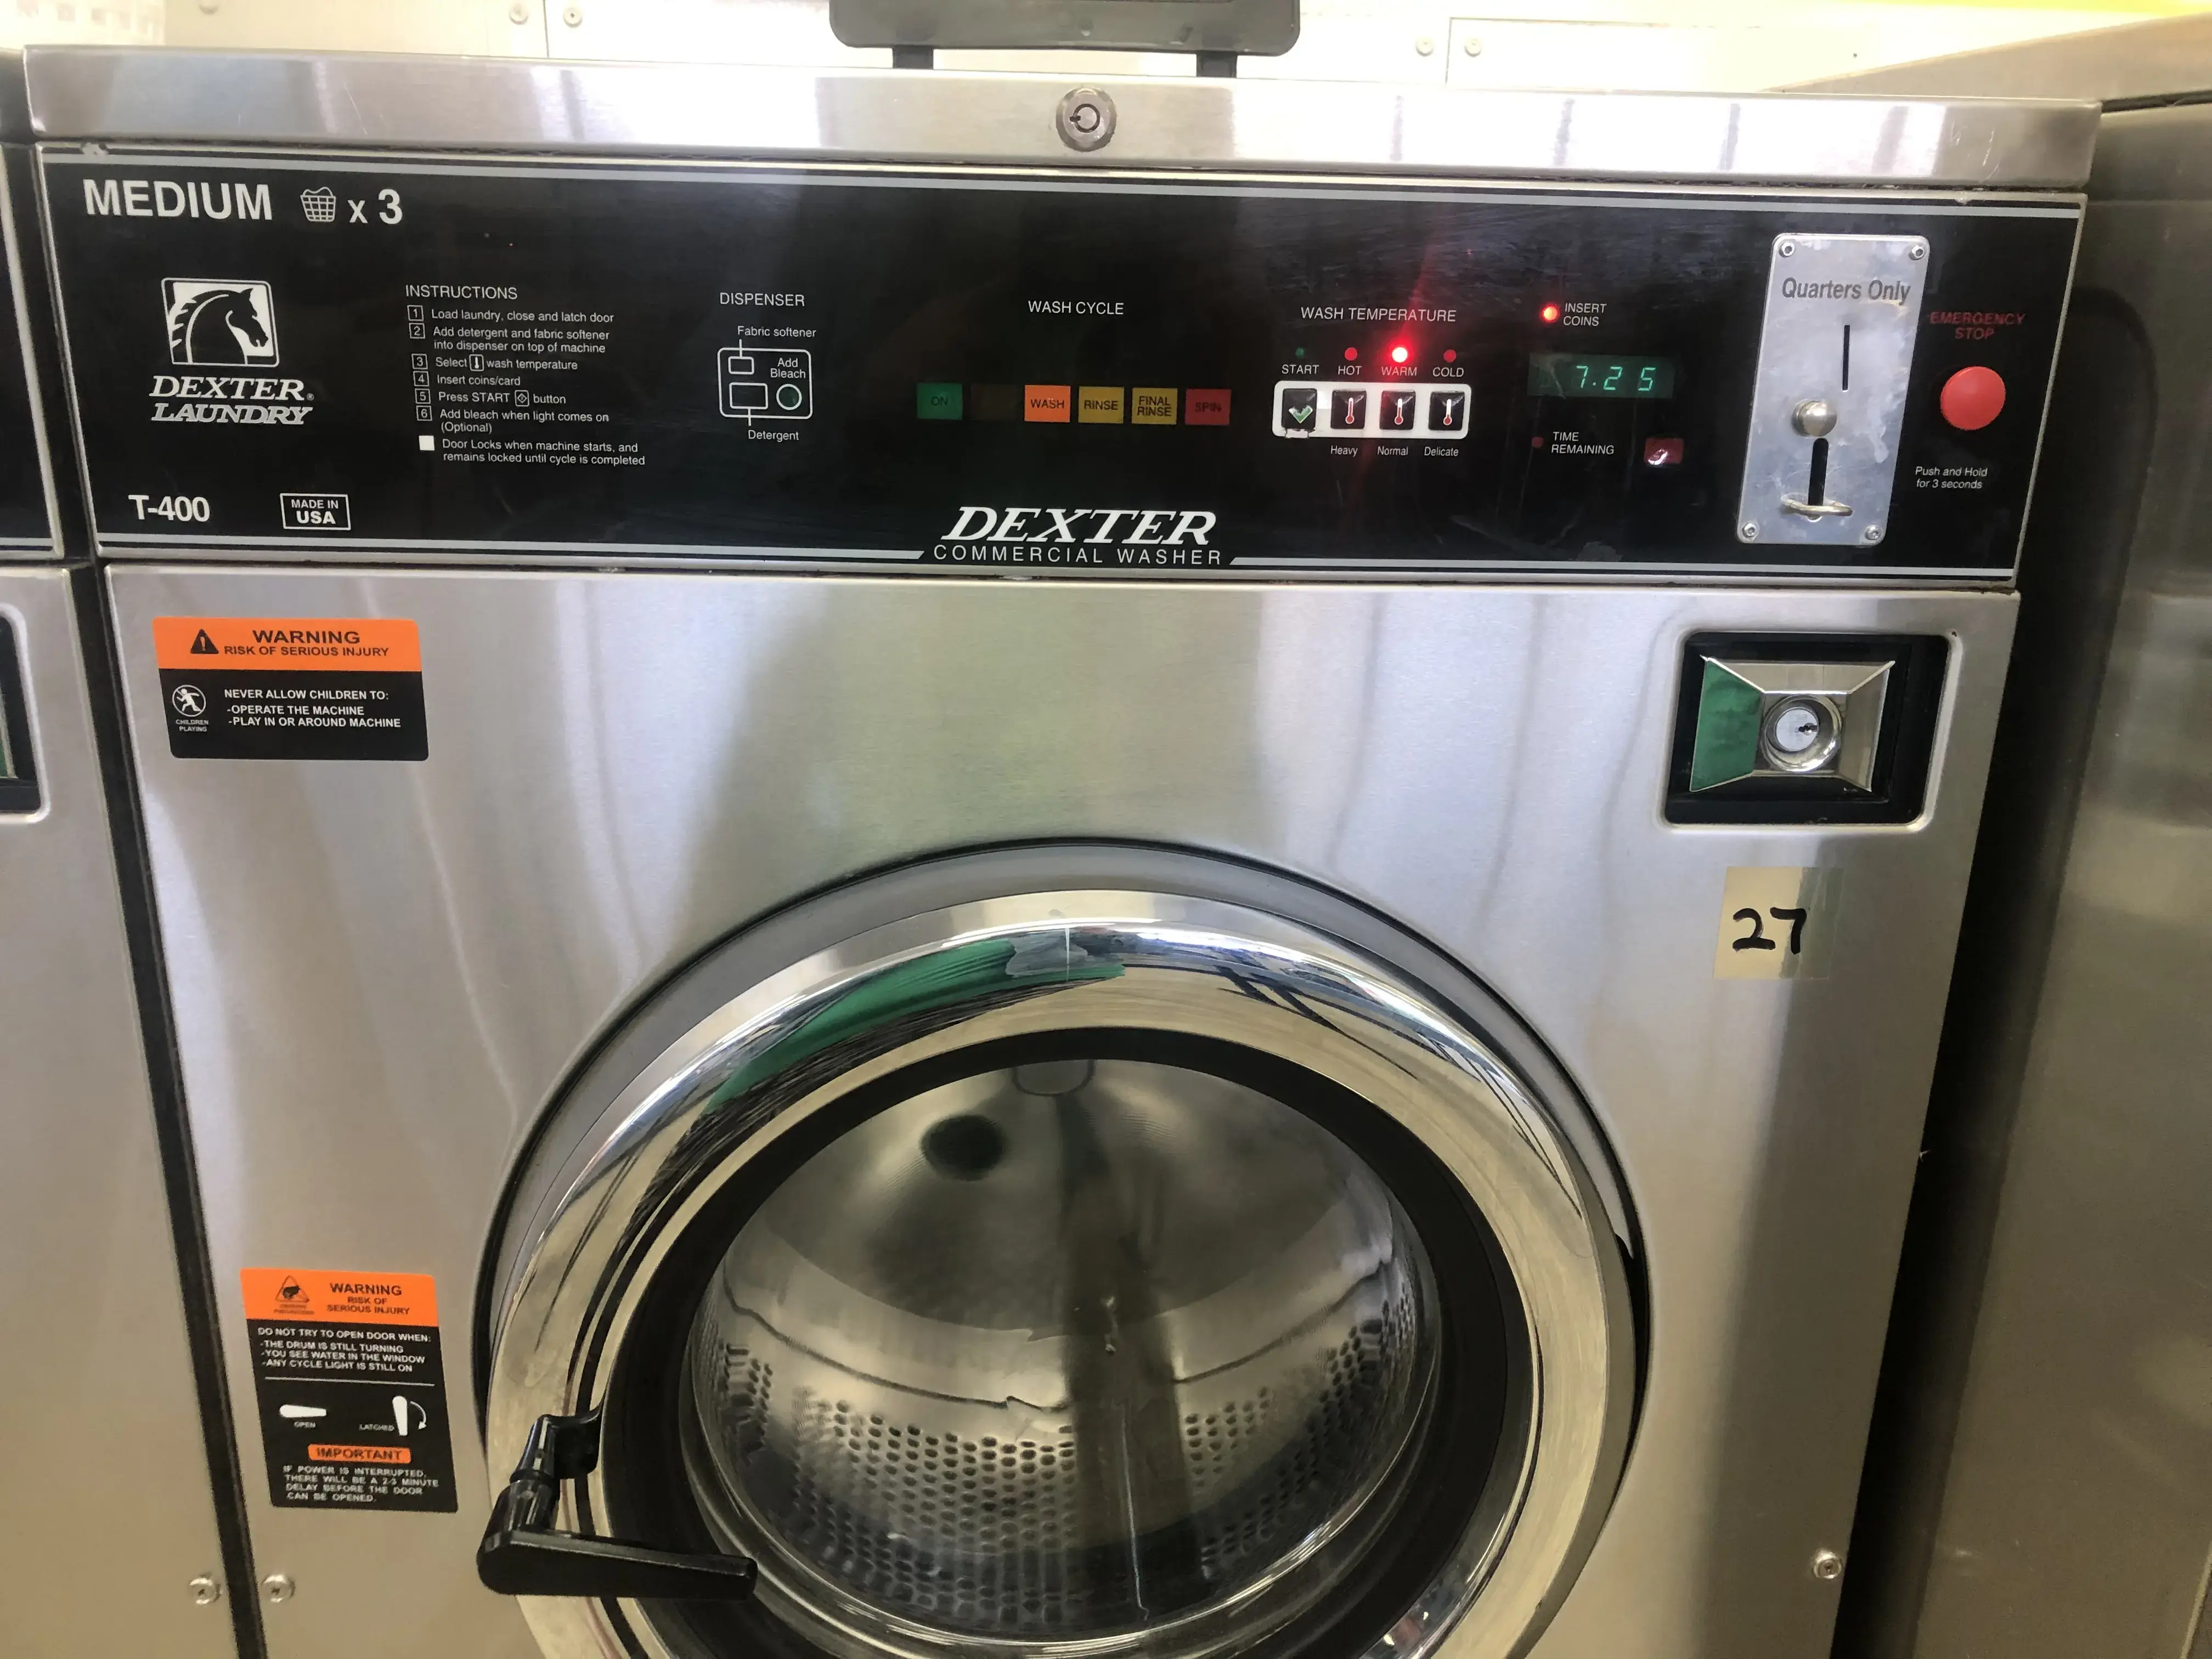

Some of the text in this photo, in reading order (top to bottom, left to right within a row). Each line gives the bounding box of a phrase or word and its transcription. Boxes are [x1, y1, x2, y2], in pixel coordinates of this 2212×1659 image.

[83, 179, 273, 220] MEDIUM
[379, 189, 403, 224] 3
[405, 285, 518, 300] INSTRUCTIONS
[1782, 278, 1911, 305] Quarters Only
[720, 292, 805, 306] DISPENSER
[1028, 301, 1125, 315] WASH CYCLE
[1301, 307, 1457, 321] WASH TEMPERATURE
[1565, 303, 1607, 313] INSERT
[414, 309, 613, 323] 1 Load laundry, close and latch door
[1563, 316, 1599, 326] COINS
[1929, 312, 2025, 325] EMERGENCY
[414, 326, 609, 340] 2 Add detergent and fabric softener
[737, 325, 816, 337] Fabric softener
[1954, 327, 1995, 340] STOP
[434, 340, 453, 350] into
[456, 341, 508, 353] dispenser
[528, 343, 544, 354] top
[548, 343, 557, 352] of
[561, 343, 606, 353] machine
[416, 357, 578, 371] 3 Select wash temperature
[777, 358, 798, 368] Add
[1282, 364, 1319, 374] START
[770, 368, 806, 379] Bleach
[1338, 365, 1362, 375] HOT
[1381, 367, 1418, 376] WARM
[1432, 367, 1464, 377] COLD
[418, 374, 521, 385] 4 Insert coins/card
[420, 392, 566, 404] 5 Press START button
[930, 396, 948, 407] ON
[1030, 398, 1065, 410] WASH
[1138, 396, 1171, 407] FINAL
[1083, 399, 1118, 411] RINSE
[1195, 402, 1221, 413] SPIN
[151, 403, 313, 425] LAUNDRY
[421, 409, 609, 423] 6 Add bleach when light comes on
[1136, 406, 1172, 417] RINSE
[441, 422, 492, 434] (Optional)
[748, 430, 799, 442] Detergent
[1553, 432, 1579, 442] TIME
[442, 439, 638, 454] Door Locks when machine starts, and
[1330, 445, 1358, 457] Heavy
[1377, 446, 1408, 456] Normal
[1424, 447, 1459, 457] Delicate
[1551, 444, 1614, 454] REMAINING
[443, 452, 645, 467] remains locked until cycle is completed
[1915, 466, 1988, 477] Push and Hold
[1916, 478, 1983, 489] for 3 seconds
[128, 494, 210, 522] T-400
[290, 499, 339, 509] MADE IN
[296, 510, 336, 525] USA
[941, 506, 1217, 545] DEXTER
[934, 544, 1221, 565] COMMERCIAL WASHER
[252, 630, 360, 645] WARNING
[224, 646, 389, 657] RISK OF SERIOUS INJURY
[224, 690, 389, 700] NEVER ALLOW CHILDREN TO:
[227, 705, 364, 715] -OPERATE THE MACHINE
[228, 717, 401, 728] -PLAY IN OR AROUND MACHINE
[1733, 906, 1808, 955] 27
[330, 1282, 402, 1296] WARNING
[327, 1304, 409, 1315] SERIOUS INJURY
[258, 1327, 273, 1335] DO
[275, 1328, 296, 1336] NOT
[298, 1328, 318, 1337] TRY
[320, 1329, 334, 1338] TO
[336, 1330, 364, 1339] OPEN
[366, 1331, 396, 1340] DOOR
[286, 1341, 316, 1349] DRUM
[318, 1342, 328, 1350] IS
[330, 1342, 357, 1351] STILL
[359, 1344, 404, 1353] TURNING
[289, 1350, 309, 1358] SEE
[311, 1351, 346, 1359] WATER
[361, 1353, 380, 1362] THE
[382, 1354, 425, 1364] WINDOW
[289, 1359, 323, 1369] CYCLE
[325, 1361, 354, 1369] LIGHT
[369, 1363, 396, 1371] STILL
[398, 1364, 413, 1372] ON
[317, 1447, 403, 1460] IMPORTANT
